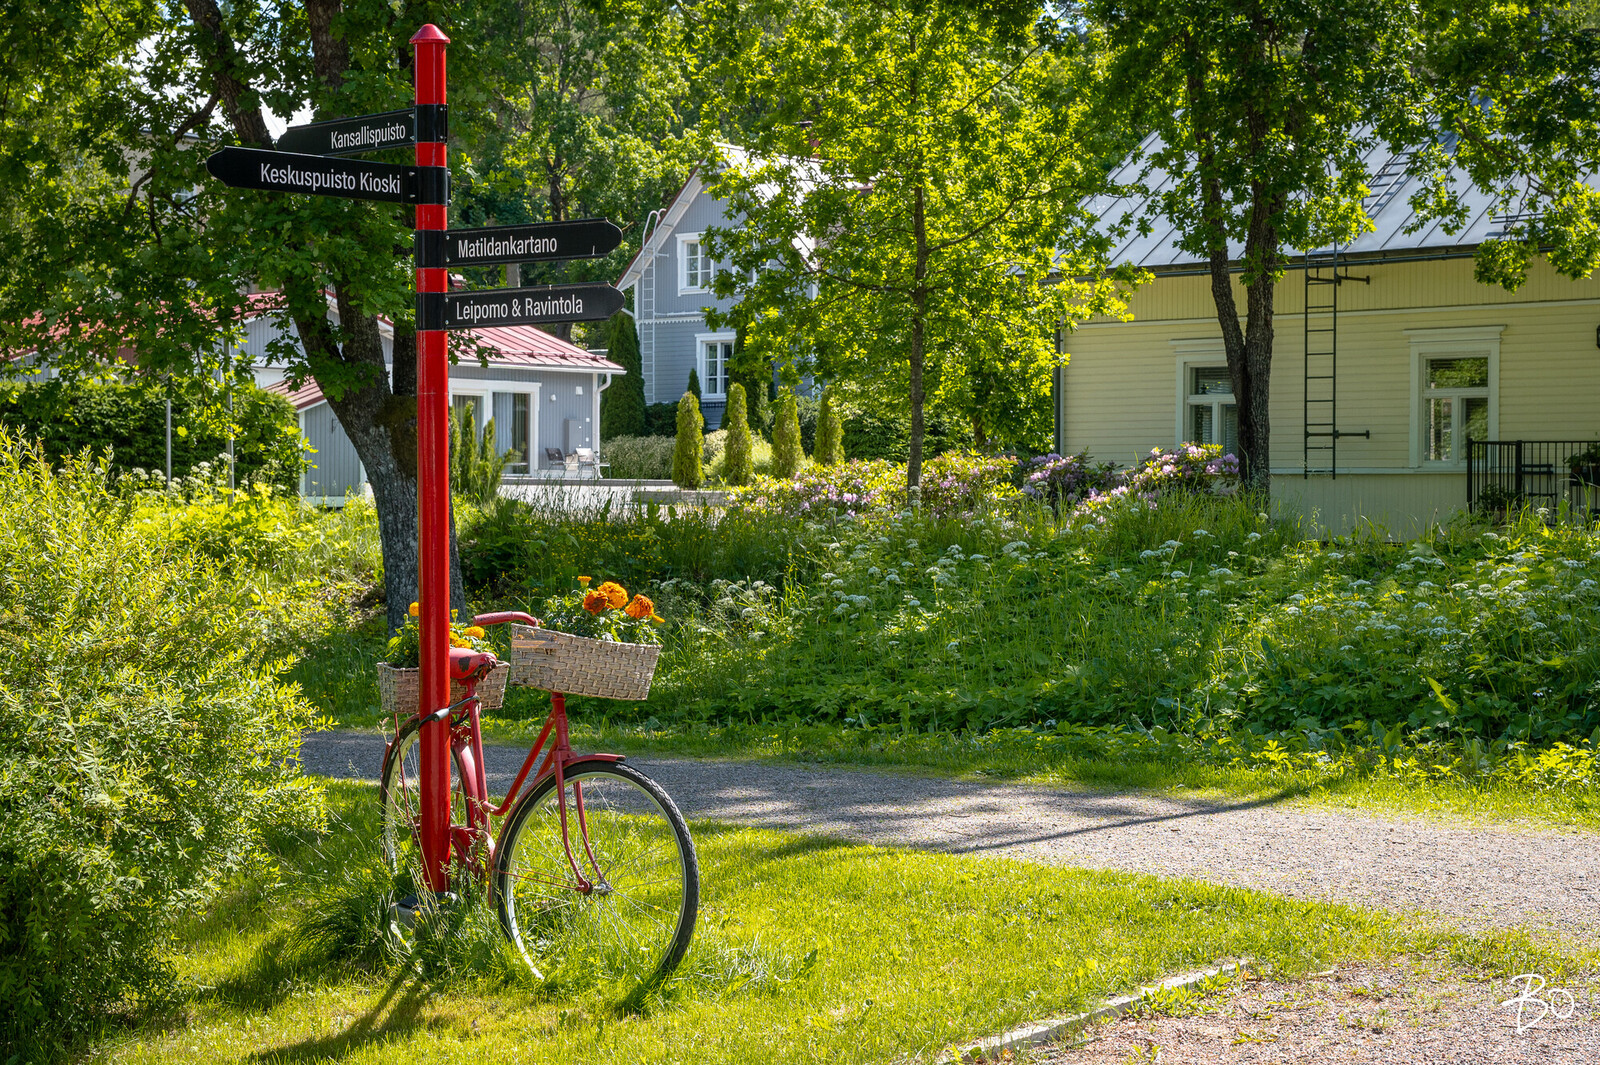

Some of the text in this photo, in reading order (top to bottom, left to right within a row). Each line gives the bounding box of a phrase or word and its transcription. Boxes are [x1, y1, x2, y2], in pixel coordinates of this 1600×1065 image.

[331, 123, 406, 149] Kansallispuisto
[261, 163, 400, 194] Keskuspuisto Kioski
[458, 235, 558, 258] Matildankartano
[456, 294, 583, 323] Leipomo & Ravintola
